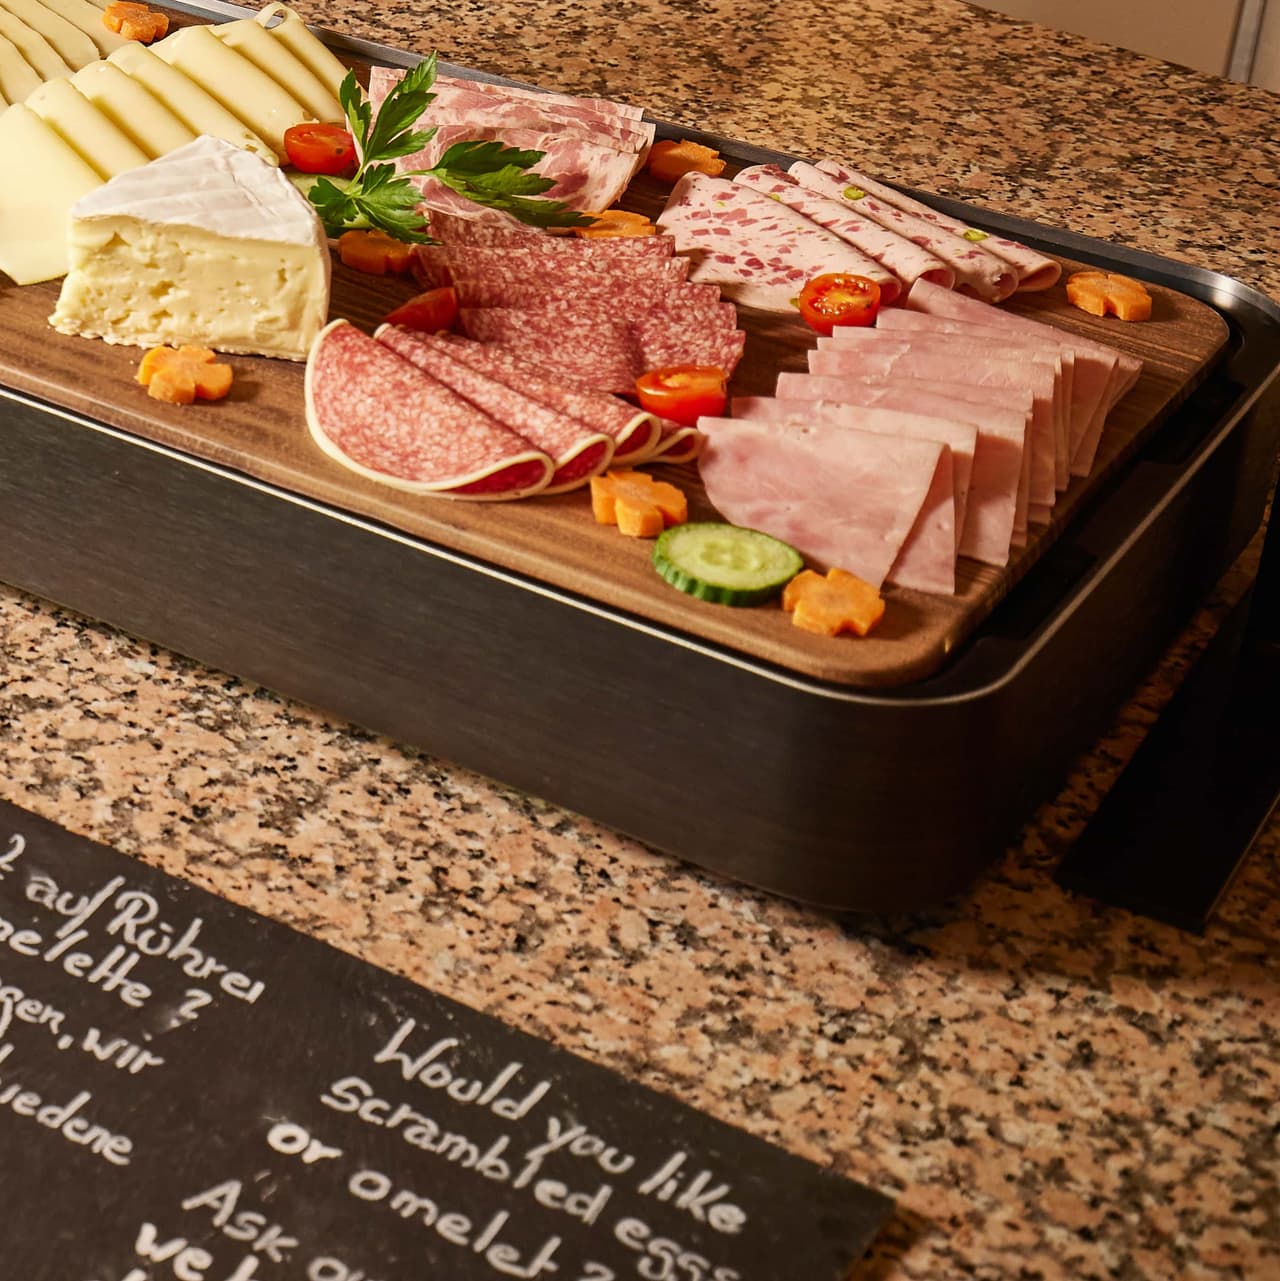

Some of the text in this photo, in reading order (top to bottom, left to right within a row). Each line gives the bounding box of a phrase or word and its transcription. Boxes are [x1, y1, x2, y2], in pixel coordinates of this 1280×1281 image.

[24, 875, 126, 938] auf
[107, 890, 265, 1003] Rührei
[82, 1028, 165, 1073] wir
[373, 1018, 747, 1234] Would you like
[182, 1180, 299, 1263] Ask
[267, 1123, 342, 1163] or
[348, 1169, 559, 1279] omelet
